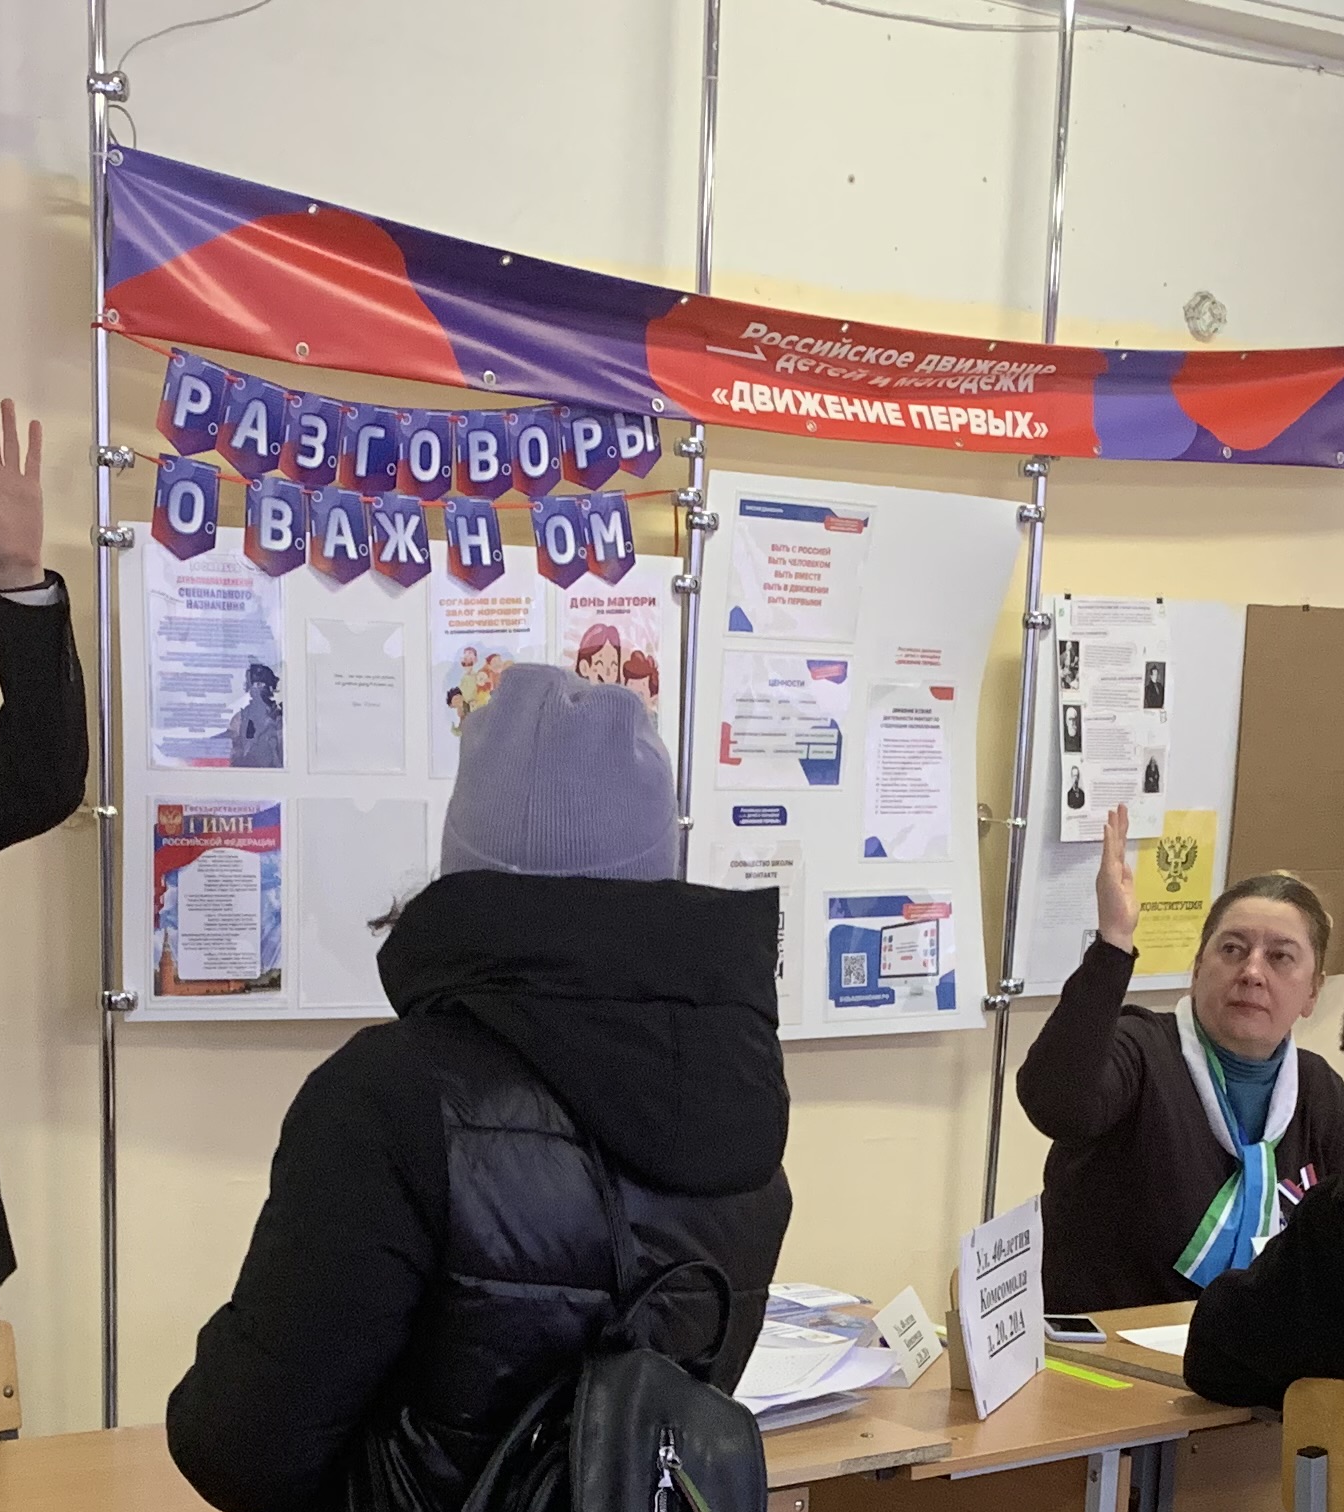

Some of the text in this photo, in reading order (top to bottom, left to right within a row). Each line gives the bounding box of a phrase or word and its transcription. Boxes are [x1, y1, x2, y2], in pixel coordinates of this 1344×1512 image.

[739, 321, 1057, 377] Российское движение
[775, 352, 868, 383] детей
[868, 372, 892, 388] и
[173, 372, 656, 484] РАЗГОВОРЫ
[711, 380, 1049, 440] «ДВИЖЕНИЕ ПЕРВЫХ»
[167, 480, 204, 534] О
[189, 816, 254, 834] ГИМН
[980, 1270, 1027, 1313] Комсомола
